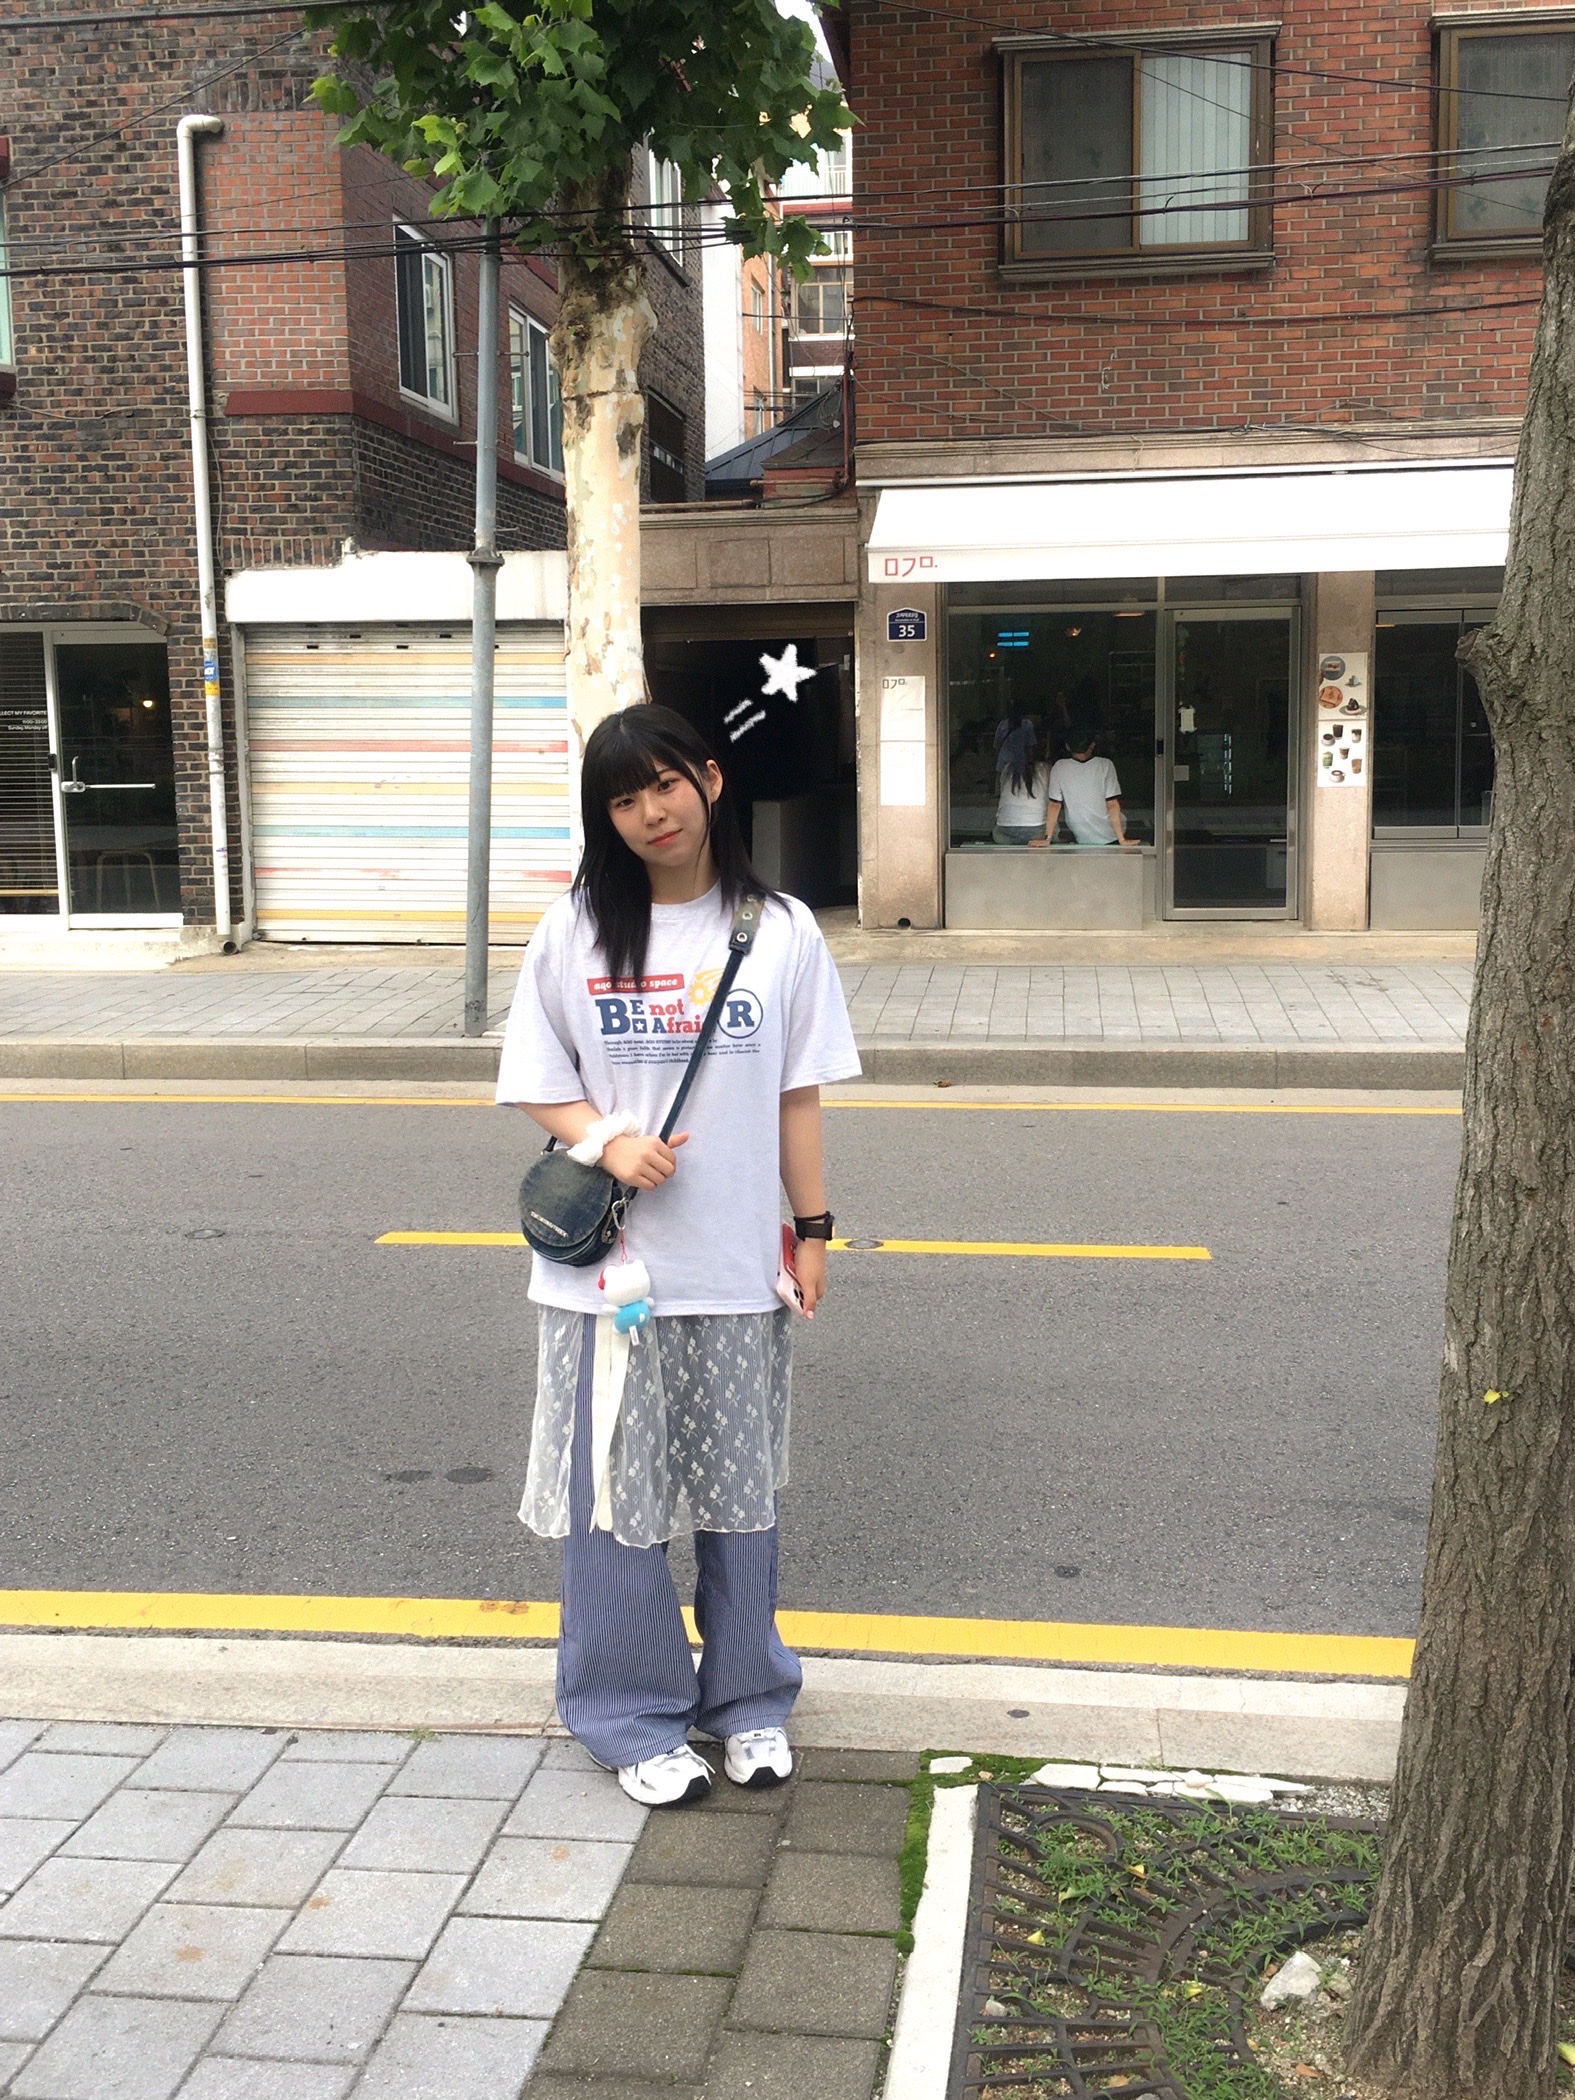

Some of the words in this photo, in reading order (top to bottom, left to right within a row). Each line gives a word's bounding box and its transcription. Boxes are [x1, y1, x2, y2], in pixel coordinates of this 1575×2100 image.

[899, 624, 915, 638] 35
[649, 978, 678, 989] space
[649, 999, 685, 1016] not
[652, 1016, 703, 1034] Afrai
